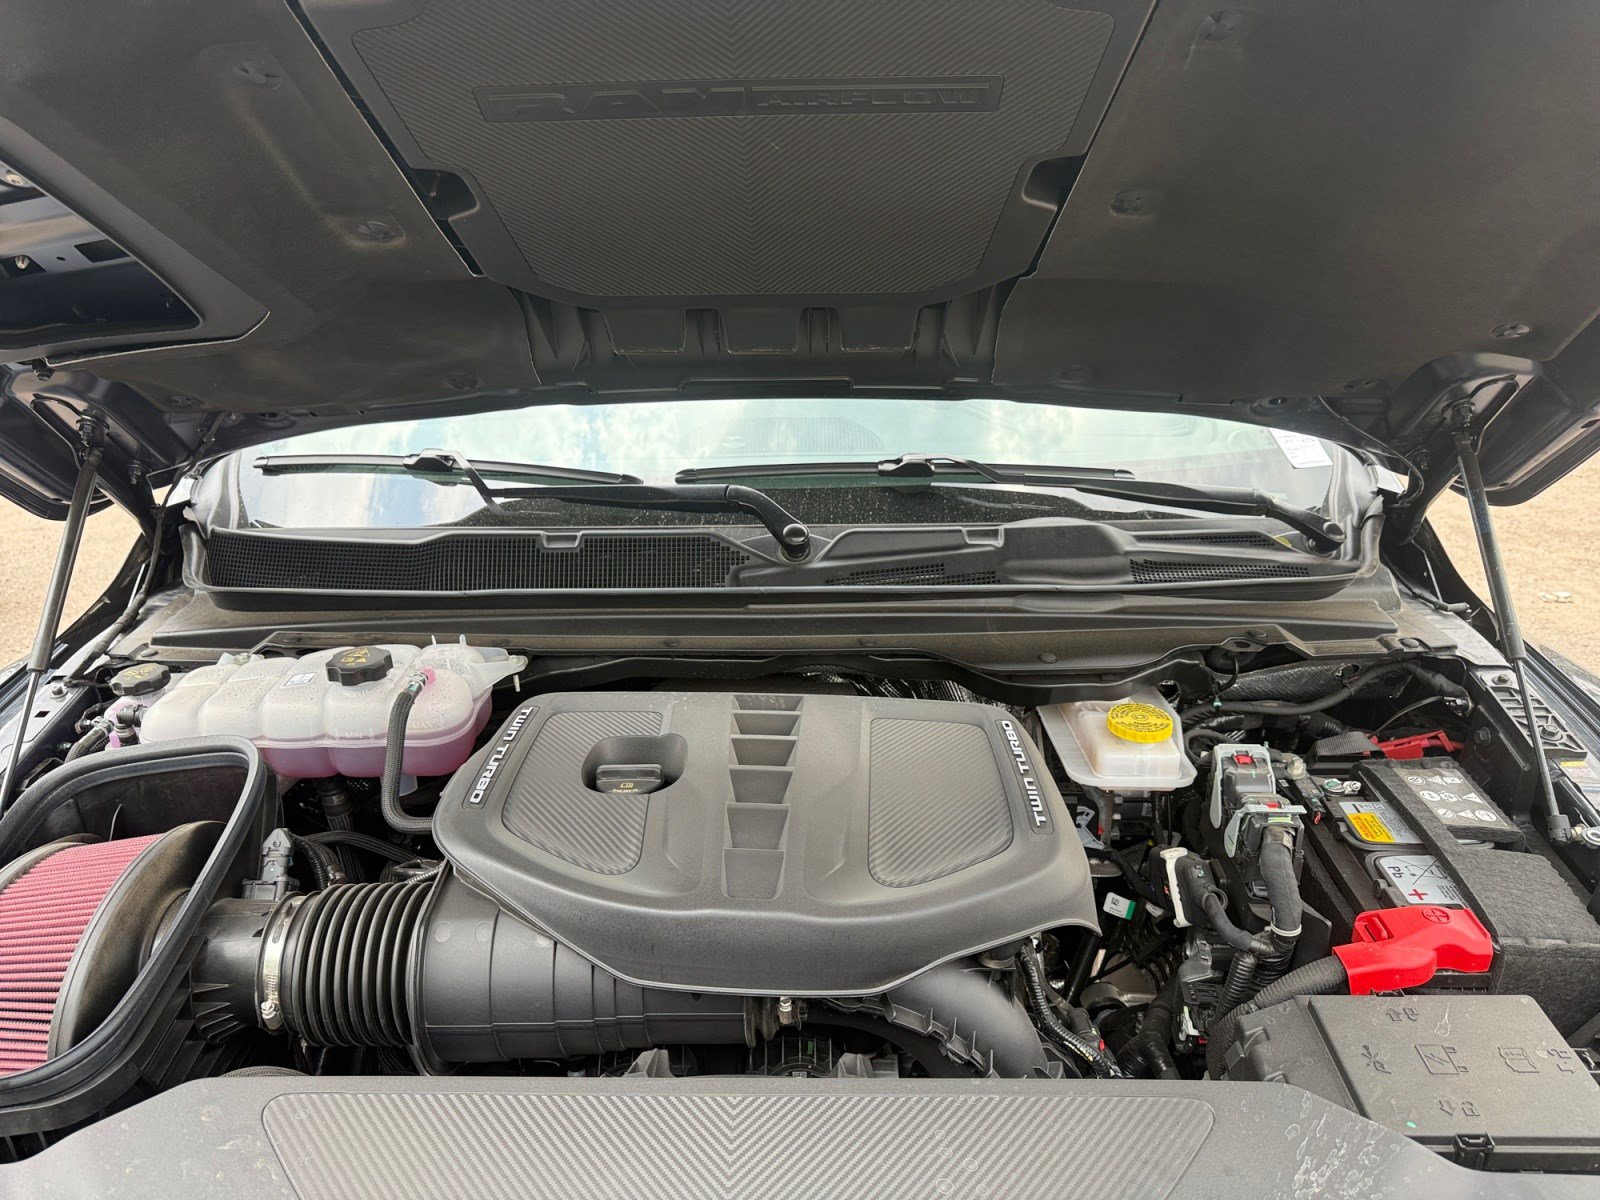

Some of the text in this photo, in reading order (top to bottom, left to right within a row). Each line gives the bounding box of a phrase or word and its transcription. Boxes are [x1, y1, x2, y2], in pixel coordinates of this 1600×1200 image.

[488, 87, 985, 117] RAM AIRFLOW
[469, 707, 533, 803] TWIN TURBO
[1001, 720, 1046, 826] TWIN TURBO
[1388, 866, 1404, 878] Pb
